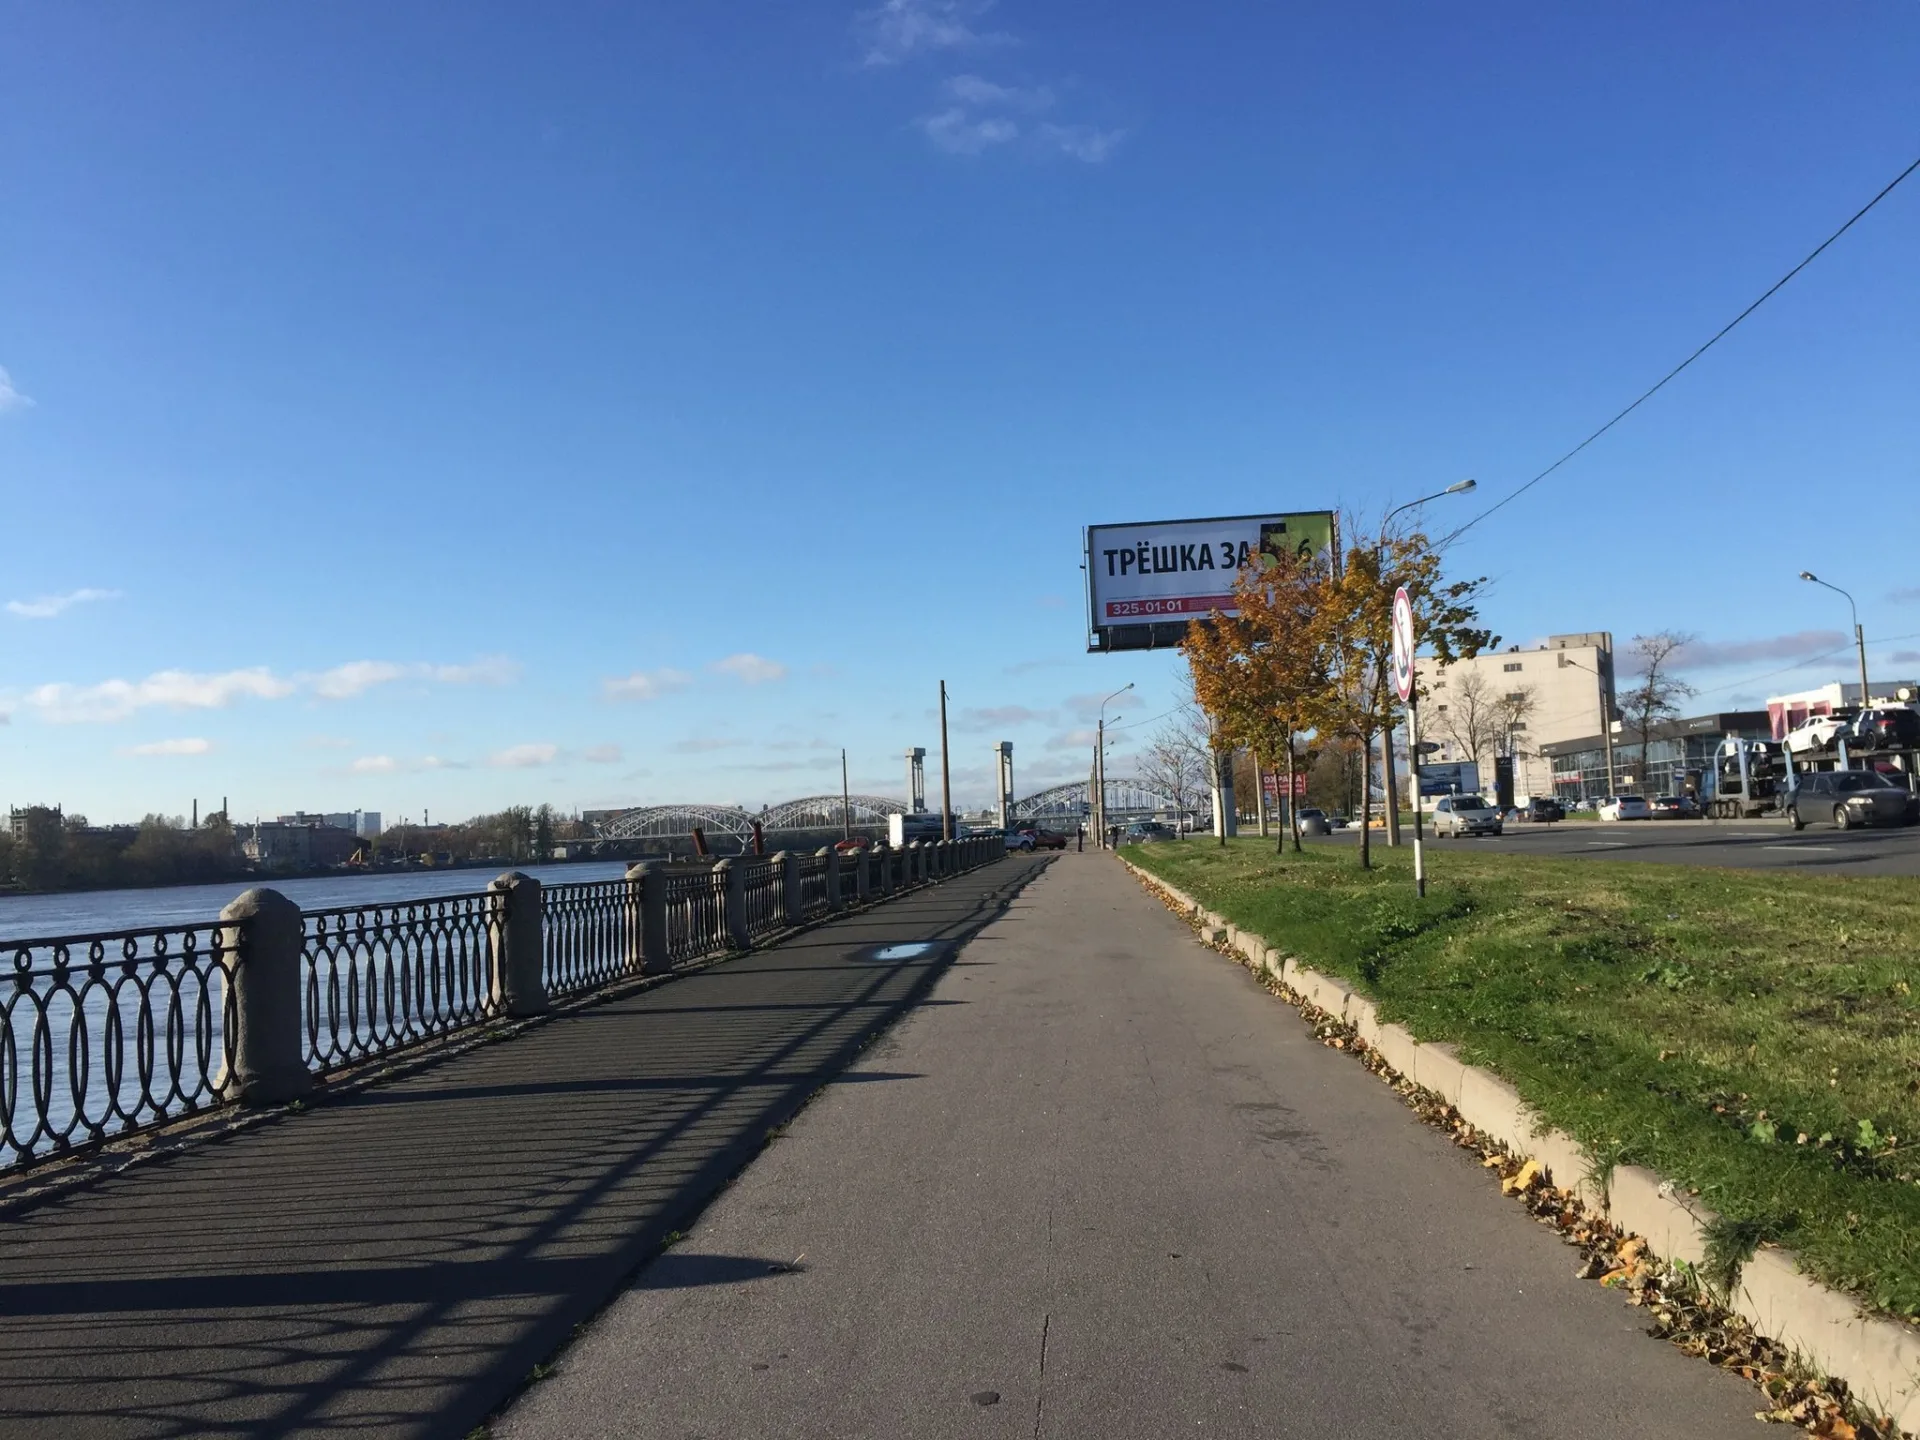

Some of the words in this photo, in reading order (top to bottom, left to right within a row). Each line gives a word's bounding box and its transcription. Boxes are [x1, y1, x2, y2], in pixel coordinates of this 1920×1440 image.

[1103, 540, 1215, 576] ТРЁШКА
[1220, 540, 1251, 570] ЗА
[1112, 600, 1183, 615] 325-01-01
